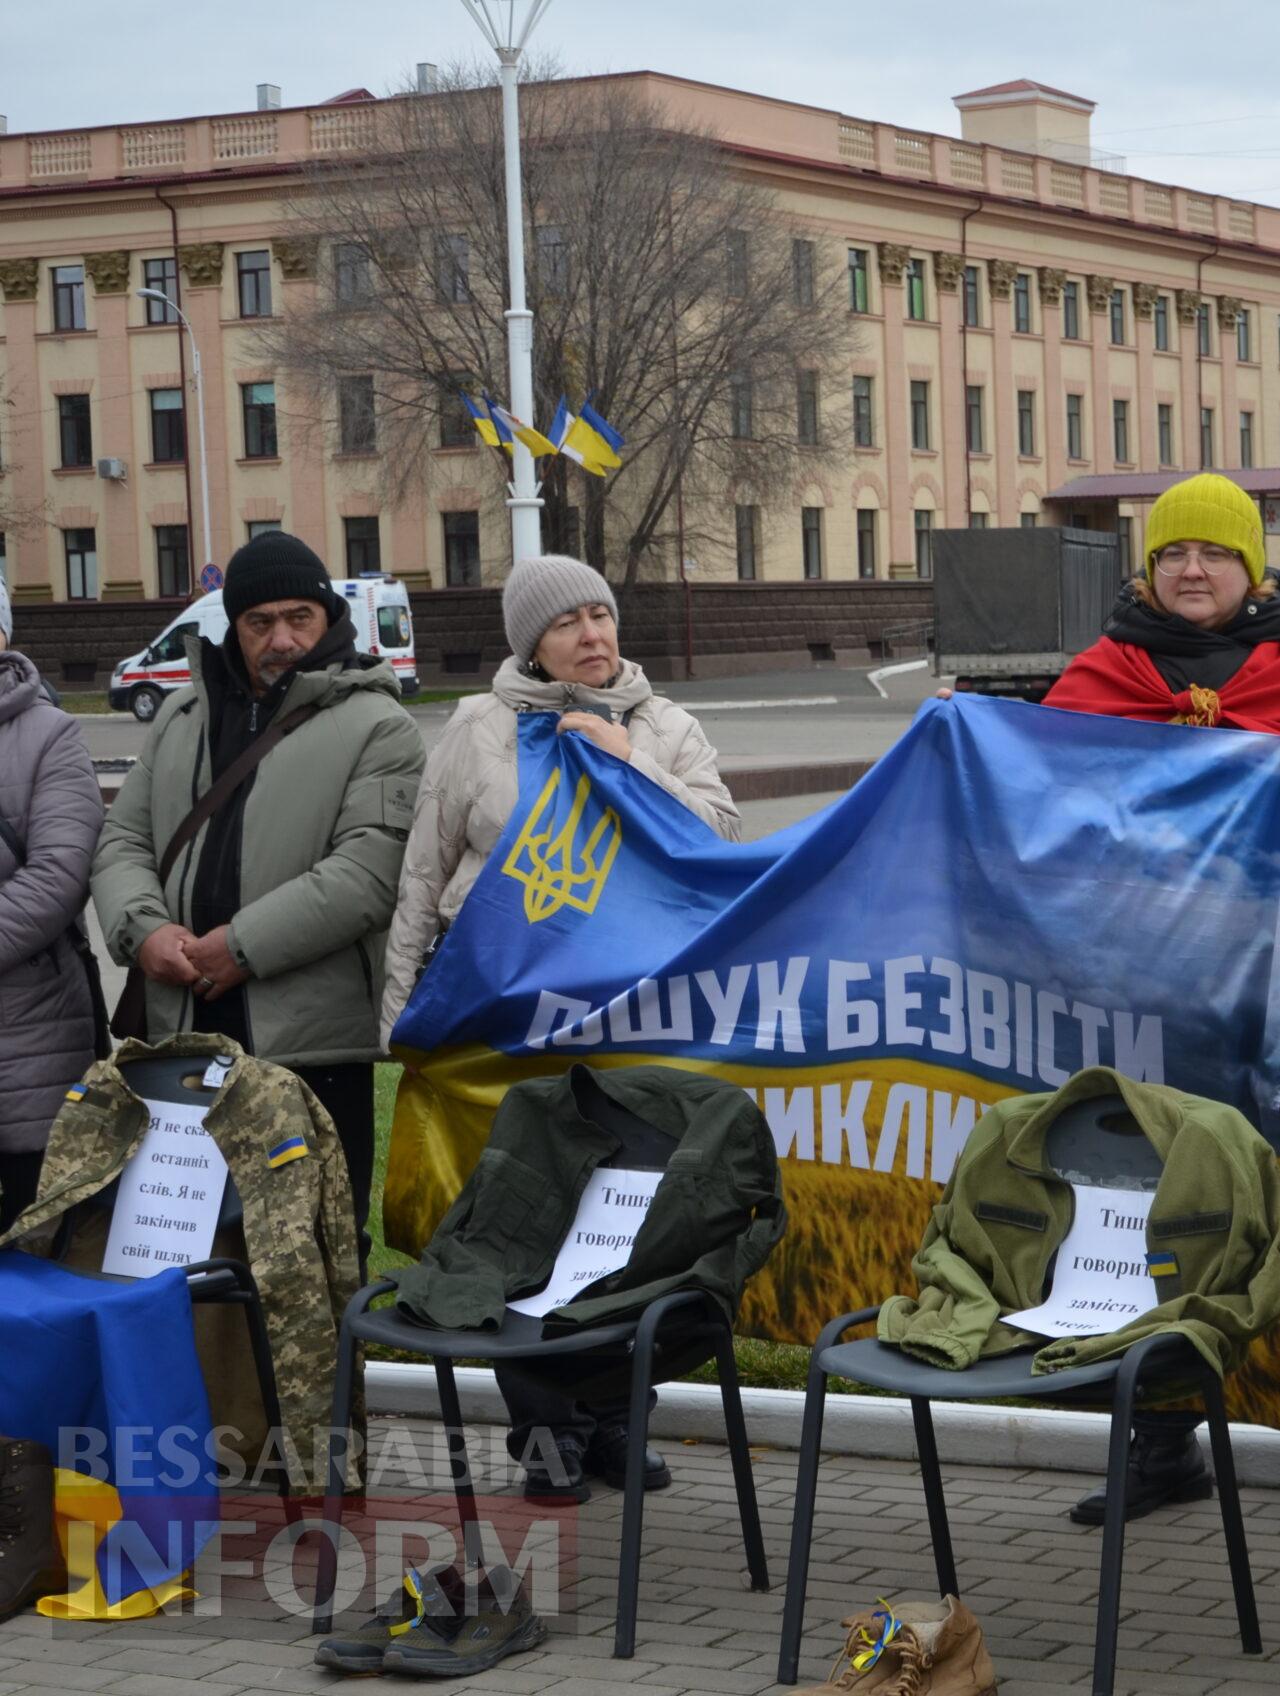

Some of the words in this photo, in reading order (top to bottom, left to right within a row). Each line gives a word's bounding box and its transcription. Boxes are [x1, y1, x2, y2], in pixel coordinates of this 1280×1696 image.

[827, 955, 1165, 1087] БЕЗВІСТИ
[148, 1117, 161, 1131] Я
[165, 1121, 181, 1133] не
[743, 1079, 991, 1185] ИКЛИ
[151, 1152, 210, 1169] останніх
[139, 1182, 173, 1197] слів.
[178, 1185, 189, 1200] Я
[192, 1190, 206, 1201] не
[134, 1214, 197, 1232] закінчив
[1100, 1208, 1145, 1231] Тиш
[122, 1244, 150, 1259] свій
[154, 1249, 192, 1265] шлях
[1066, 1298, 1139, 1314] замість
